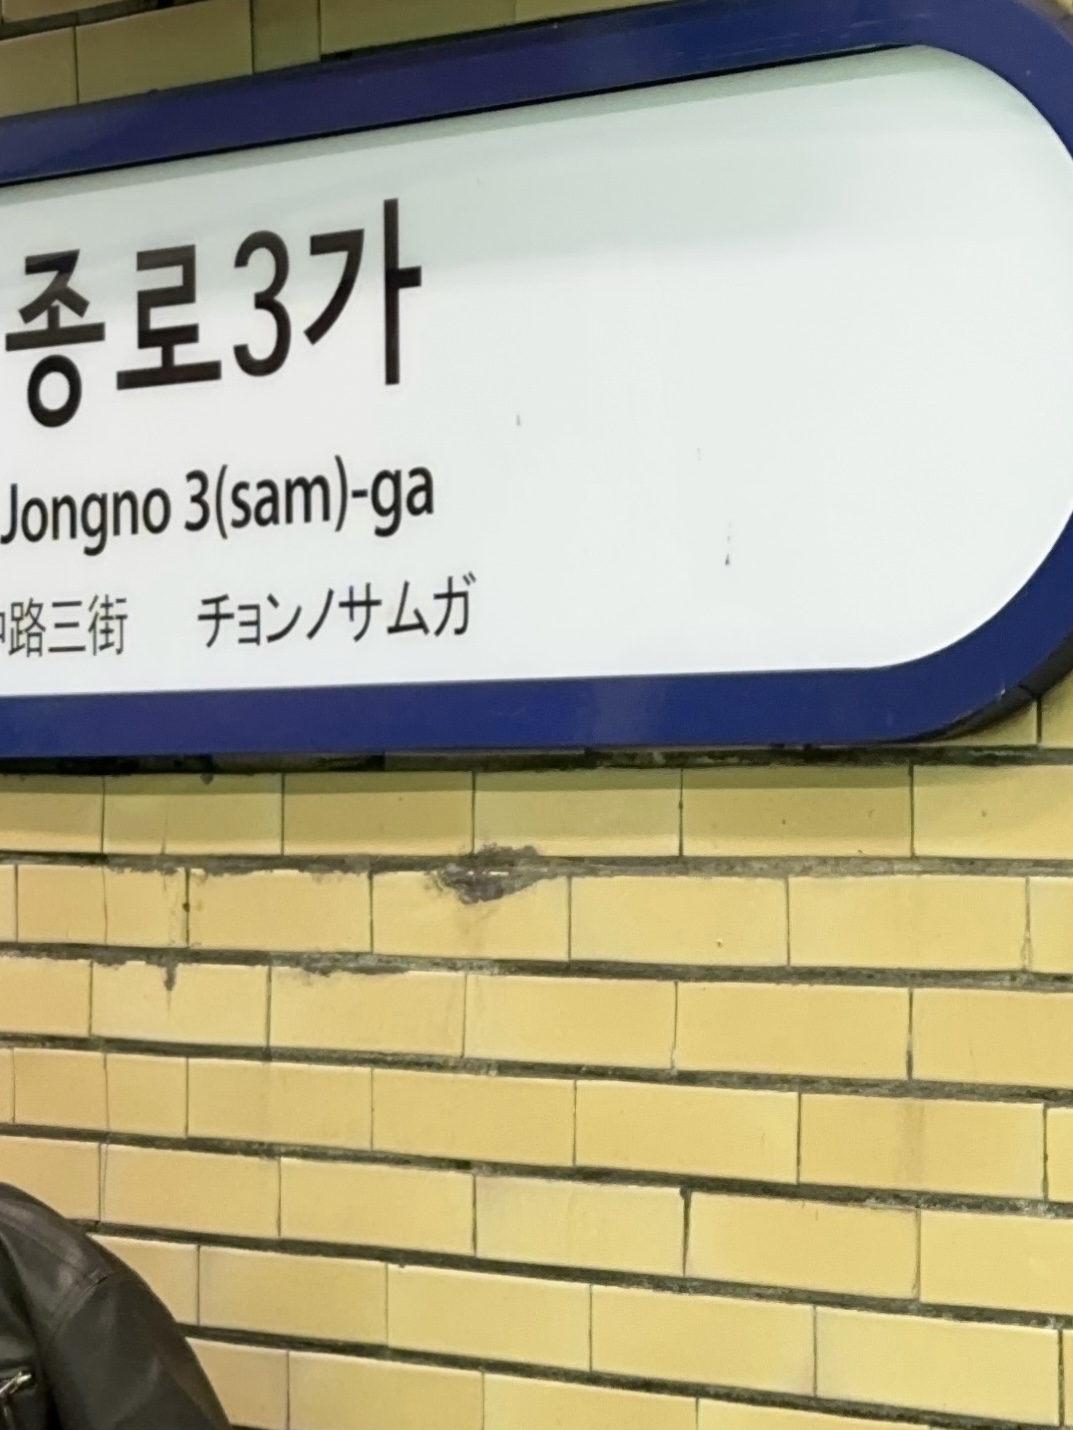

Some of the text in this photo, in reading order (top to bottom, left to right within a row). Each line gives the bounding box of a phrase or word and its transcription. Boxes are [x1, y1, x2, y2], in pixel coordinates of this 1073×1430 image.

[5, 198, 422, 428] 종로3가
[0, 455, 434, 556] Jongno 3(sam)-ga
[197, 571, 477, 648] チョンノサムガ
